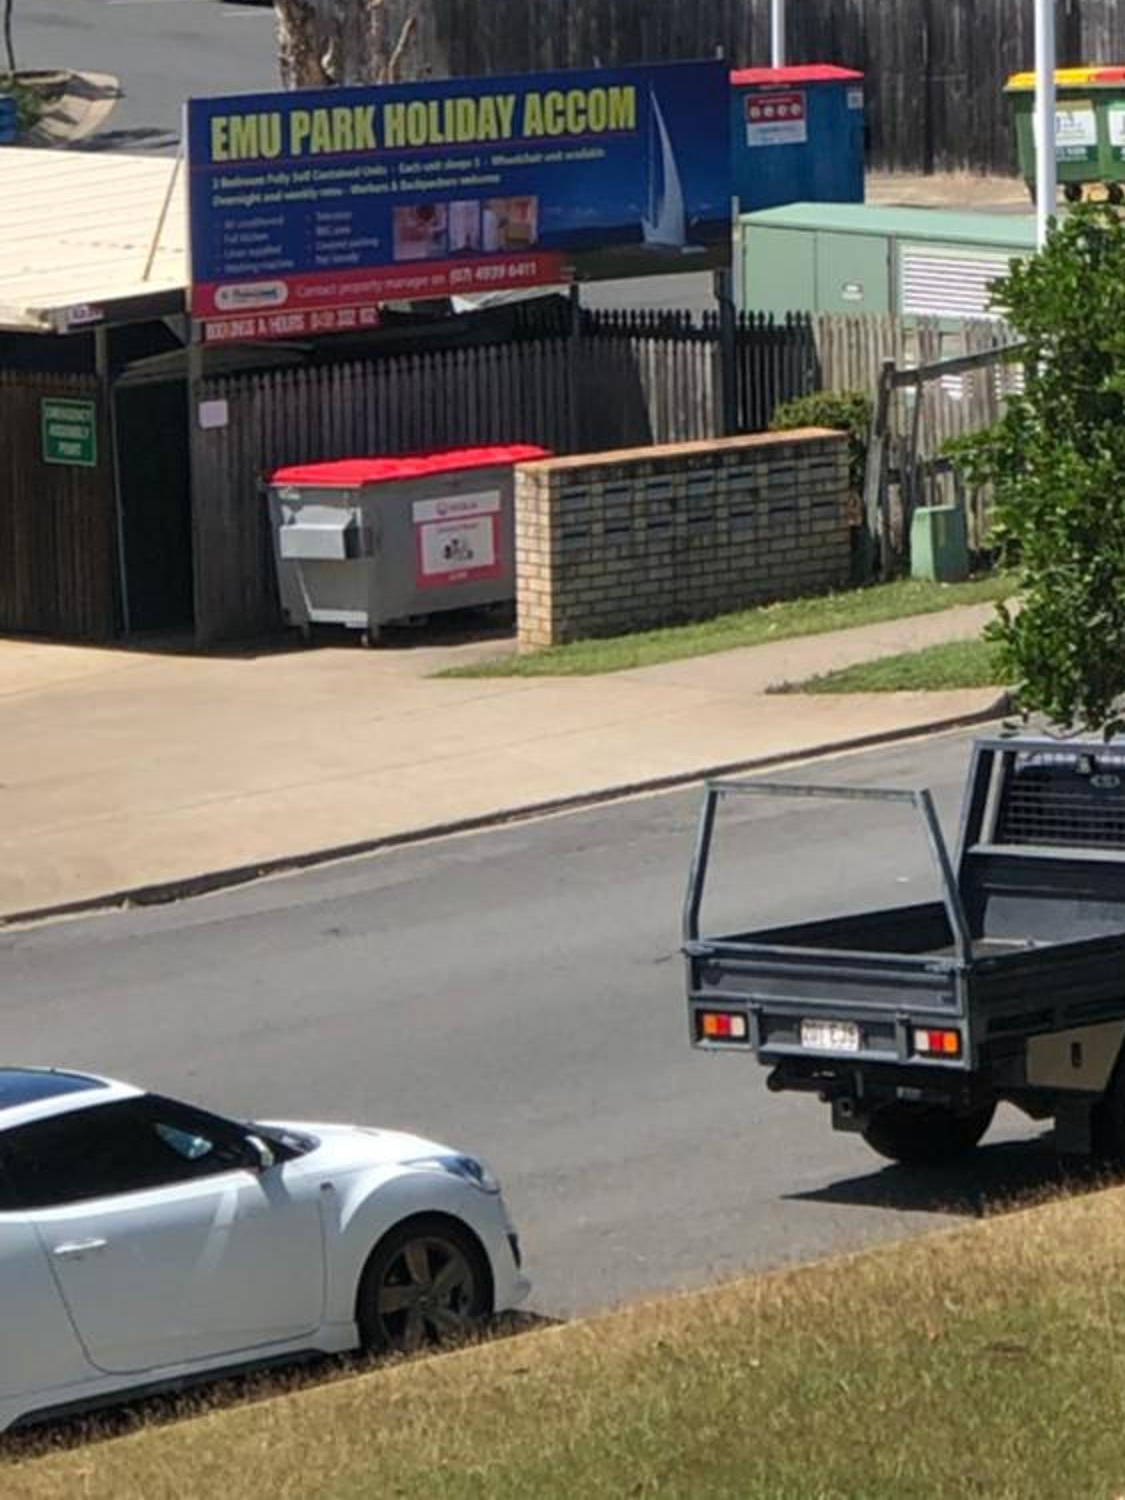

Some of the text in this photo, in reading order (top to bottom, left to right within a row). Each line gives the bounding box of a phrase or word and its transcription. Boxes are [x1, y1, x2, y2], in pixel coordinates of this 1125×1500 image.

[211, 86, 636, 162] EMU PARK HOLIDAY ACCOM
